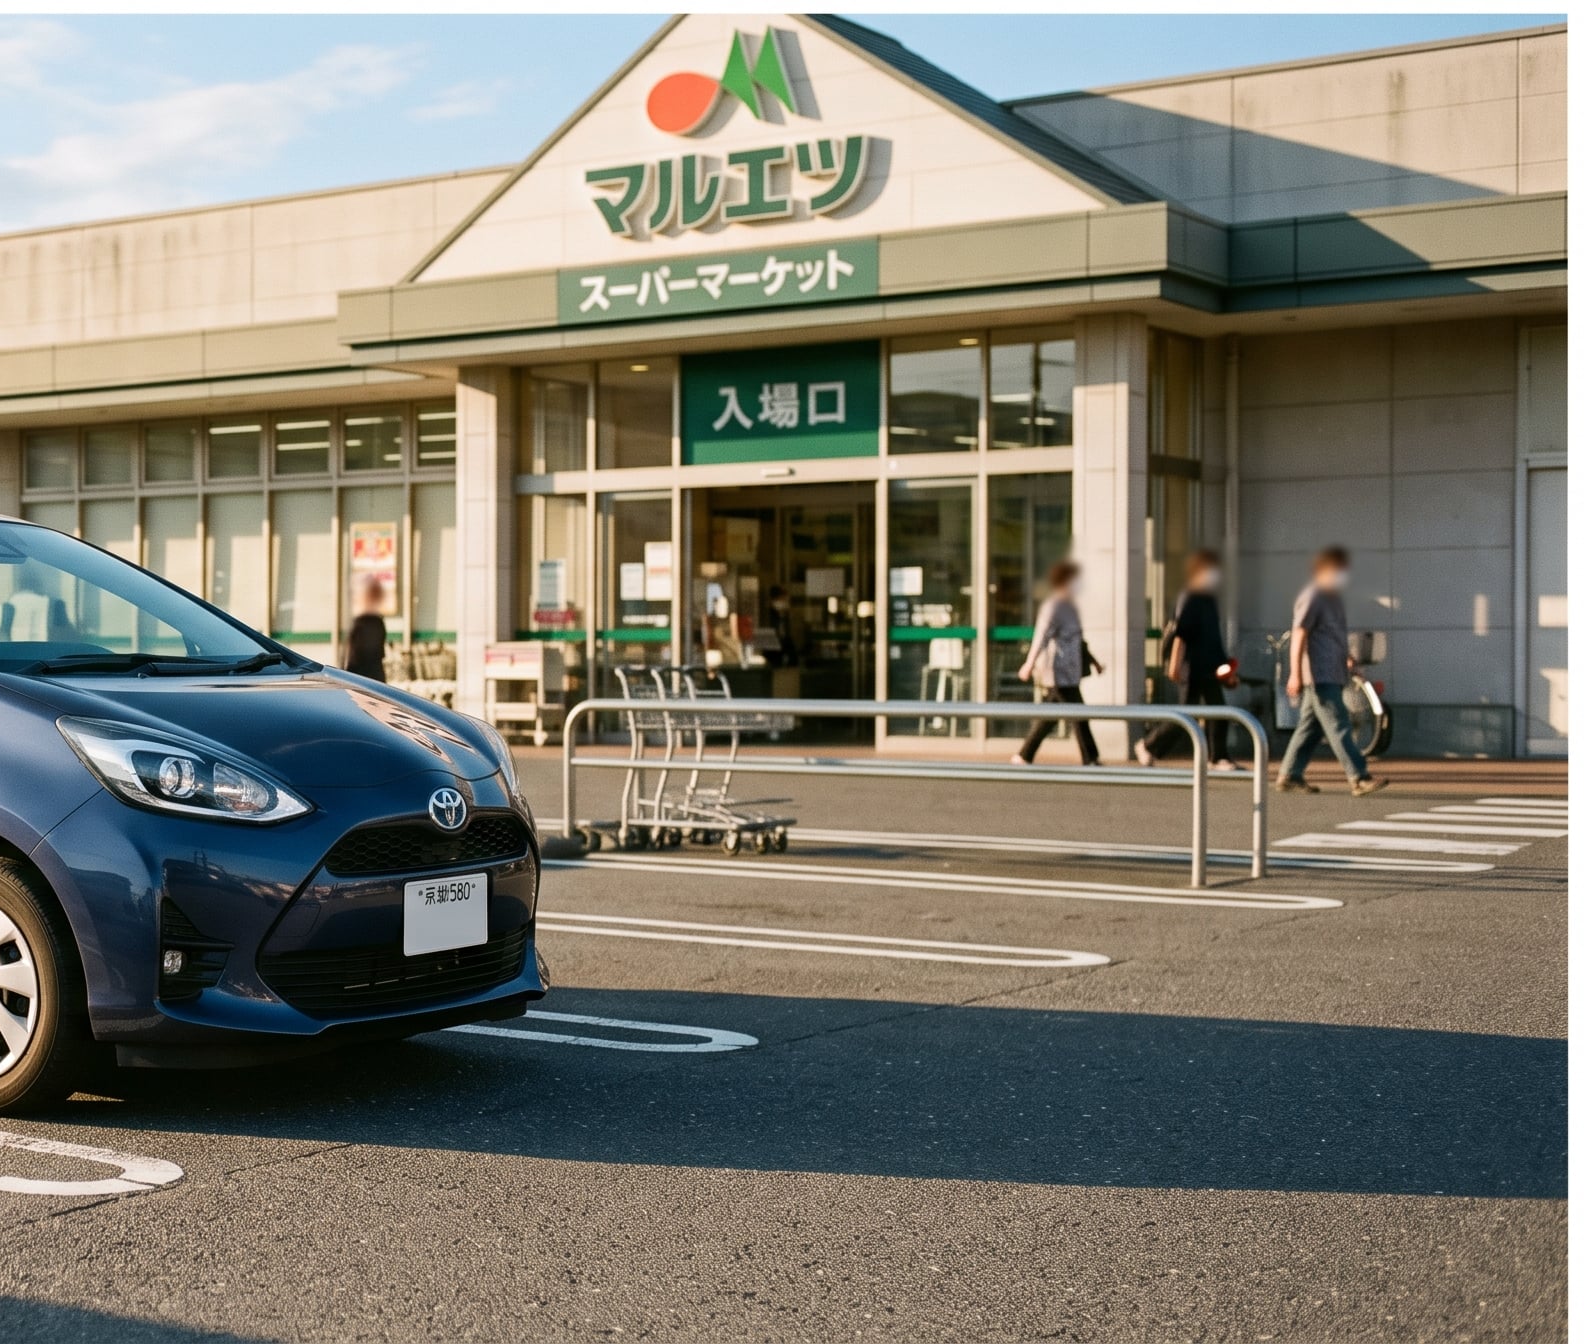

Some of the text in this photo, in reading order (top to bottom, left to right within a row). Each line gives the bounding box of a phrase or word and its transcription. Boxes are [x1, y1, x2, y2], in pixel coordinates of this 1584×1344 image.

[584, 134, 865, 236] マルエツ
[578, 248, 855, 313] スーパーマーケット
[711, 380, 847, 432] 入場口
